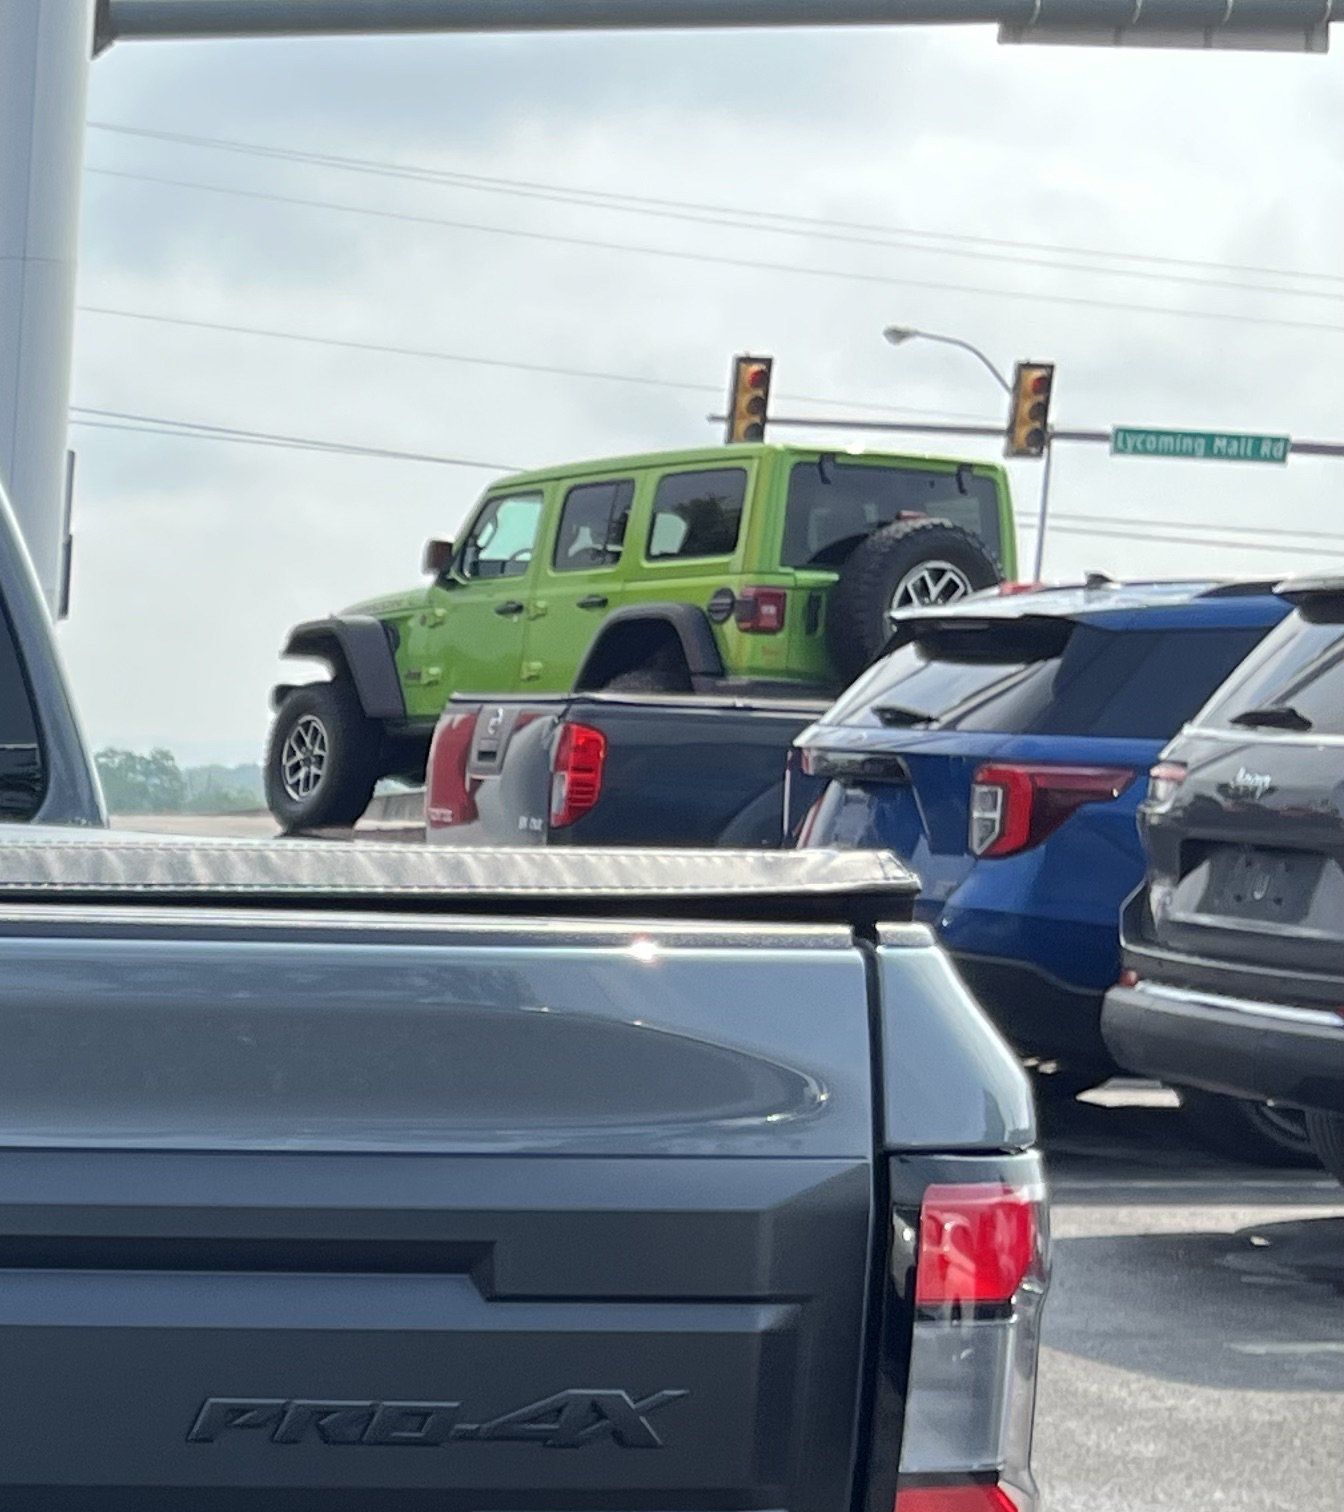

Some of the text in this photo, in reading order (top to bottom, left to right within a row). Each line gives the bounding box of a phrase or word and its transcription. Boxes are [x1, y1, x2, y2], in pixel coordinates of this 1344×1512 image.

[1116, 431, 1285, 459] Lycoming Mall Rd
[185, 1387, 690, 1449] PRO-4X
